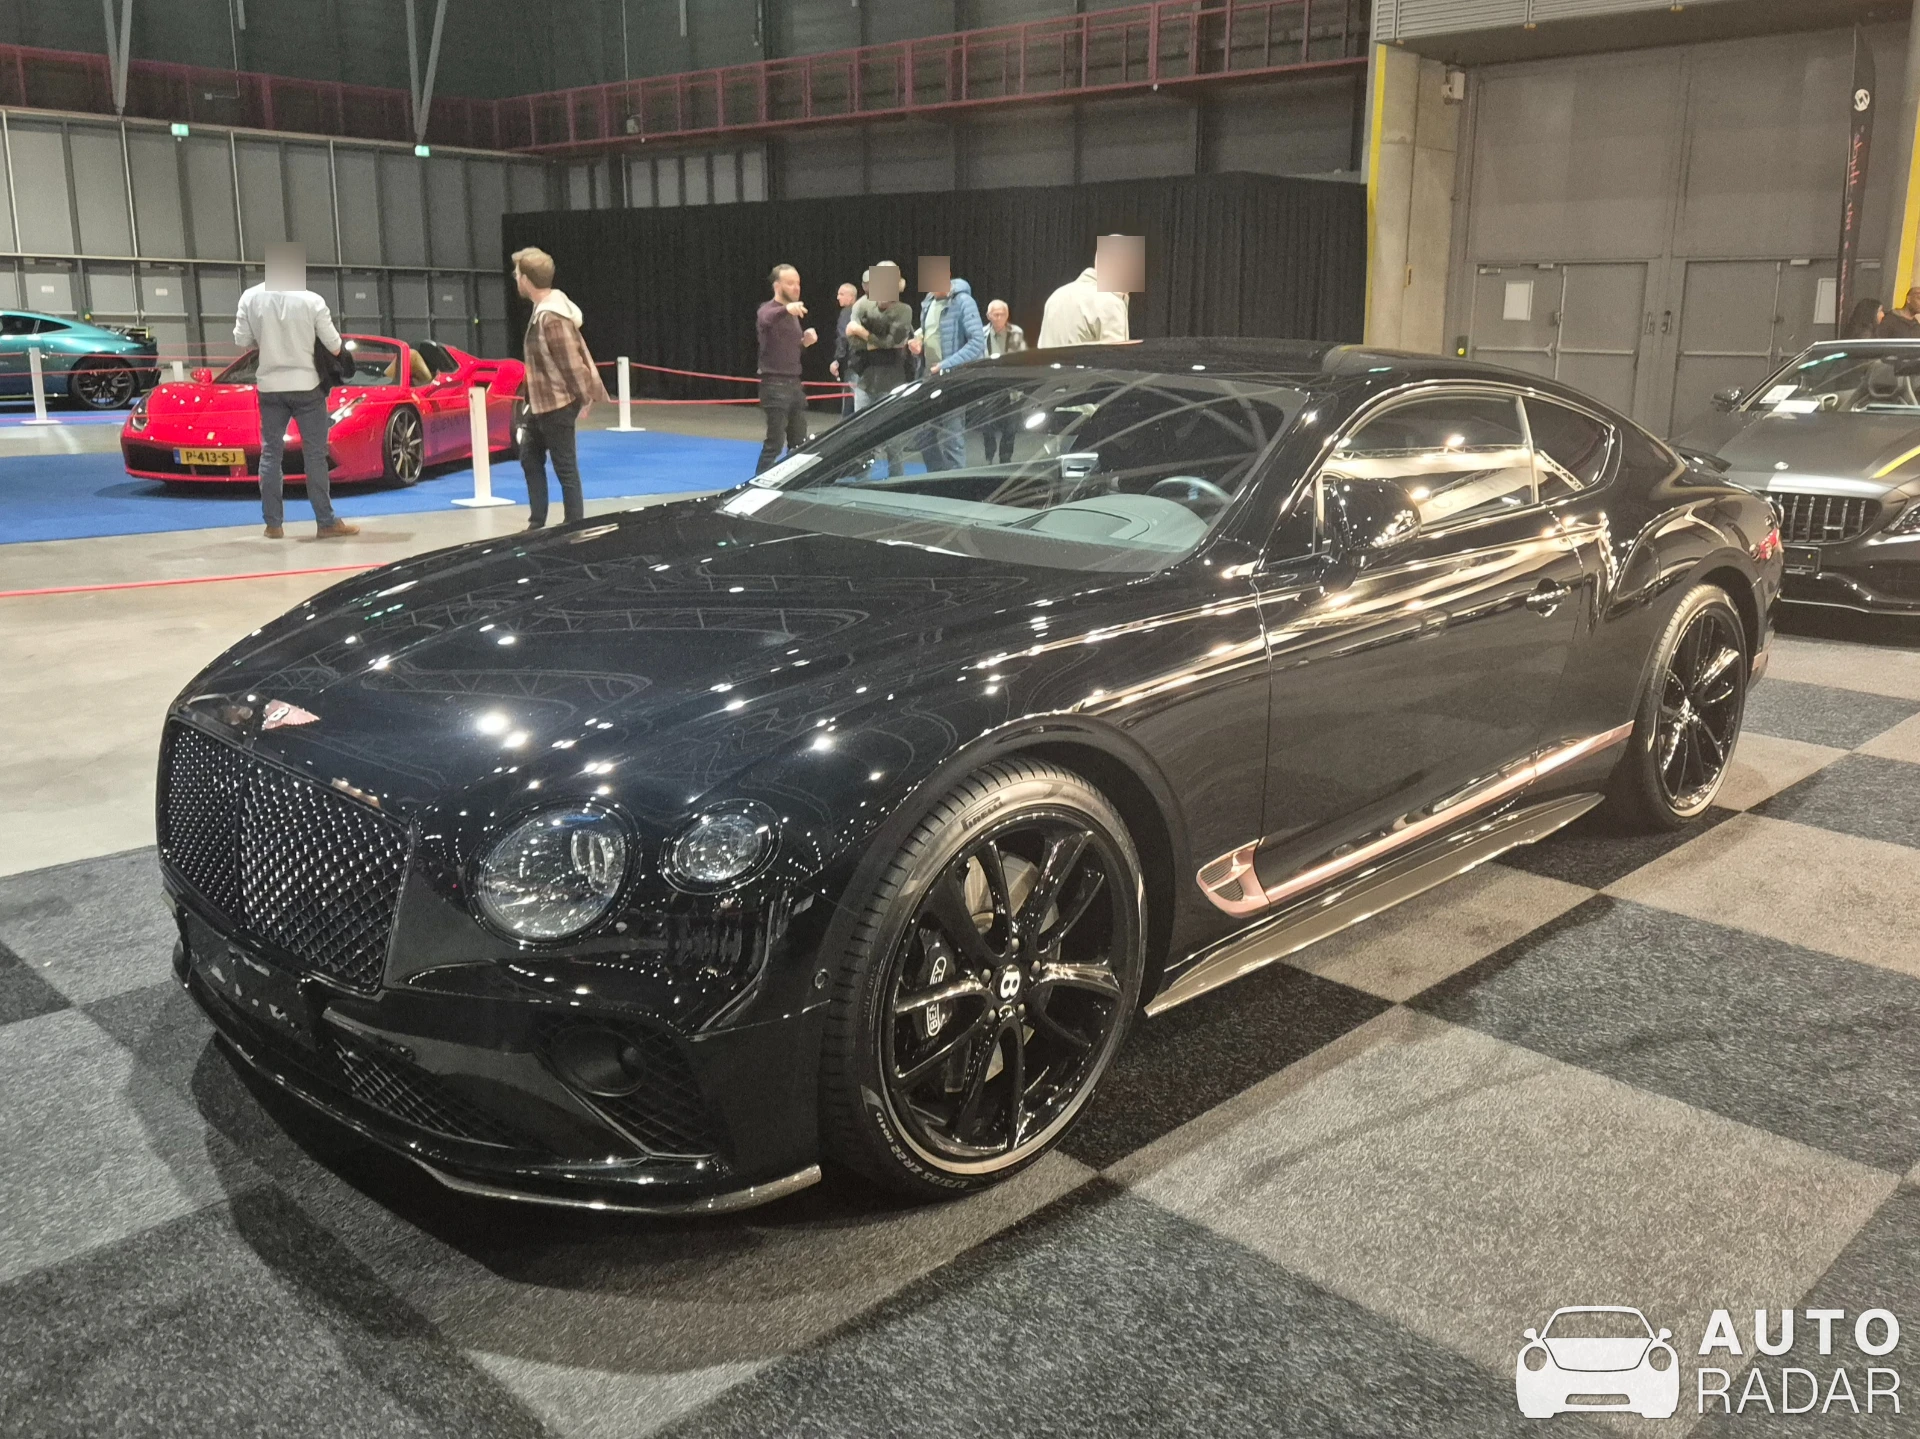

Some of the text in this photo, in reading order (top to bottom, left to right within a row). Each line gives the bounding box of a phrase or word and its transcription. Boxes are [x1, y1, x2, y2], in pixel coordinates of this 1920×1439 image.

[961, 796, 1004, 831] PIRELLI
[929, 965, 943, 1031] BENEY
[1000, 970, 1021, 999] B
